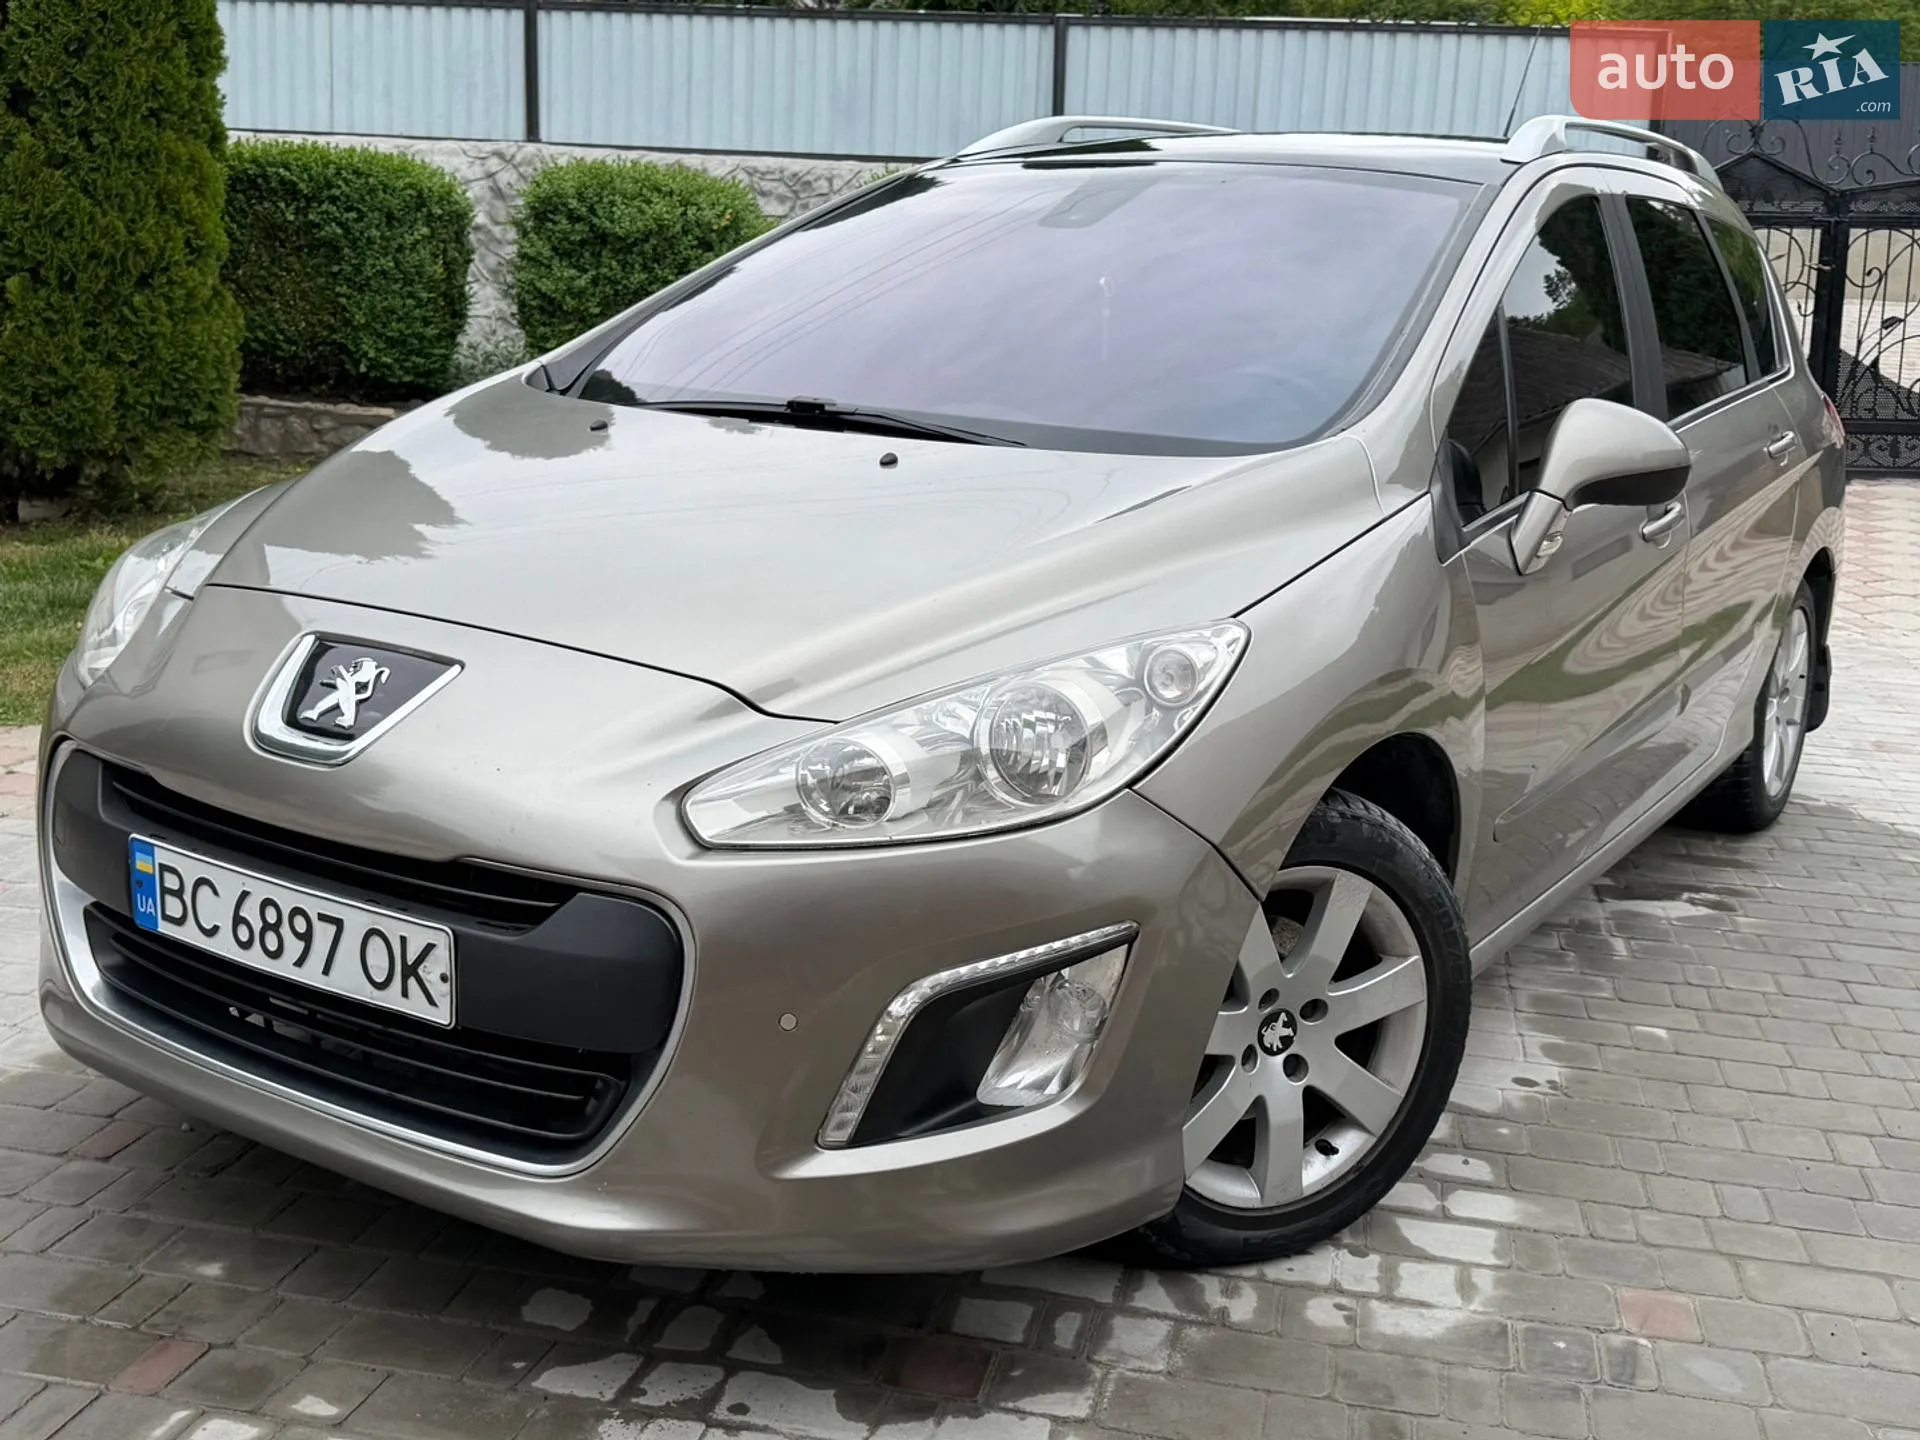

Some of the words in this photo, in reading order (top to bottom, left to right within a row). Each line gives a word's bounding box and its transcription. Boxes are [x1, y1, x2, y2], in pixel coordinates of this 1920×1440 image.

[136, 893, 156, 916] UA
[158, 862, 221, 938] BC
[231, 889, 344, 977] 6897
[359, 926, 440, 1009] OK
